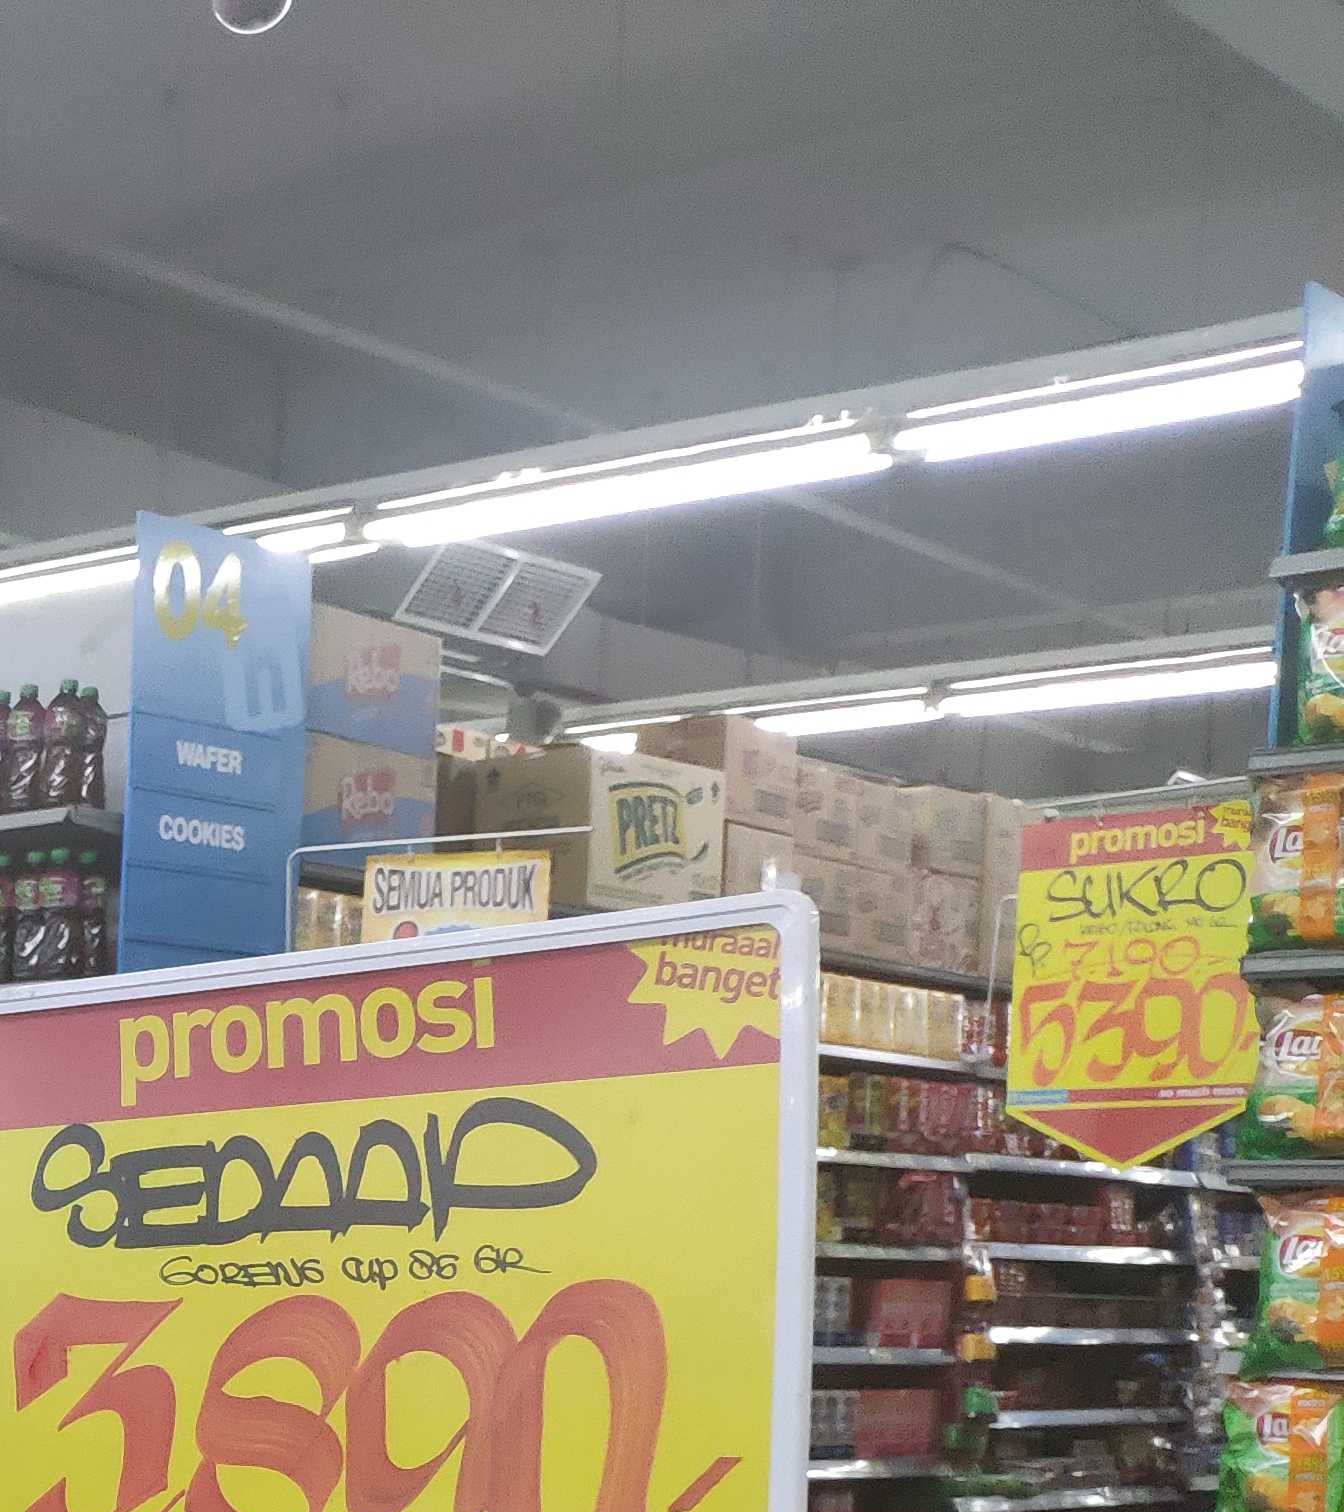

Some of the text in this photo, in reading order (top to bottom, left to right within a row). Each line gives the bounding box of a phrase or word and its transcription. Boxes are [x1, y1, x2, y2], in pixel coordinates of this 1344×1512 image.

[153, 540, 247, 649] 04
[177, 740, 242, 775] WAFER
[159, 814, 245, 851] COOKIES
[1069, 811, 1205, 865] promosi
[1220, 815, 1250, 833] bang
[373, 862, 538, 914] SEMUA PRODUK
[1047, 857, 1247, 922] SUKRO
[118, 961, 497, 1107] promosi
